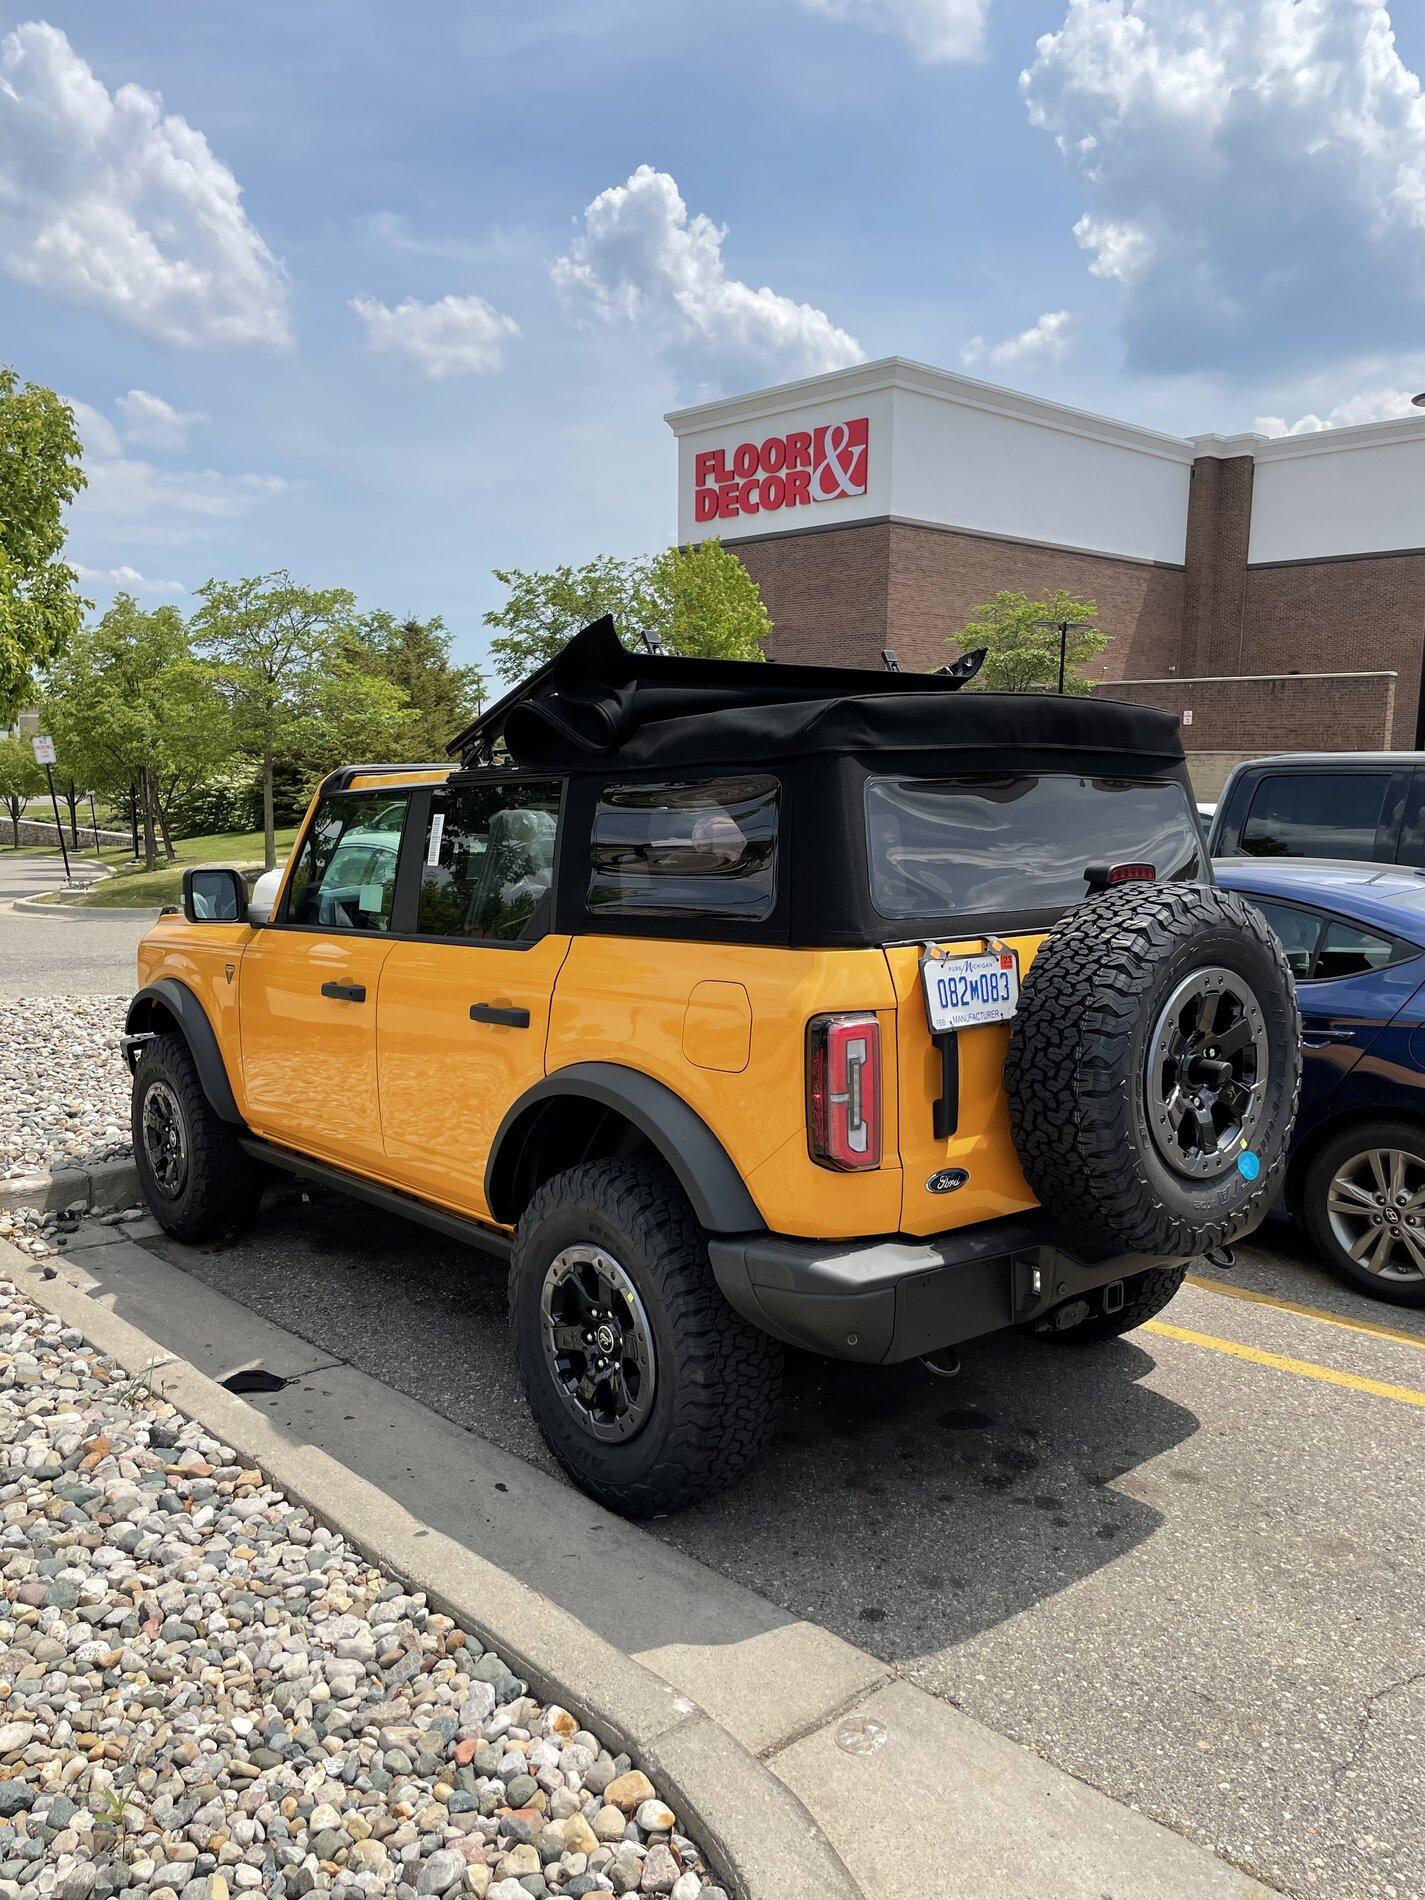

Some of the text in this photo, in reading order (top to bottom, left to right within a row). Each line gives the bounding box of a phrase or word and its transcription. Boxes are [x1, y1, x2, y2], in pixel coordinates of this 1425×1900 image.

[695, 421, 867, 502] FLOOR &
[695, 470, 812, 522] DECOR
[960, 960, 992, 973] MICHIGAN
[1003, 956, 1012, 964] 23
[937, 972, 1010, 1008] 082M083
[952, 1010, 999, 1024] MANUFACTURER
[937, 1175, 960, 1189] Ford
